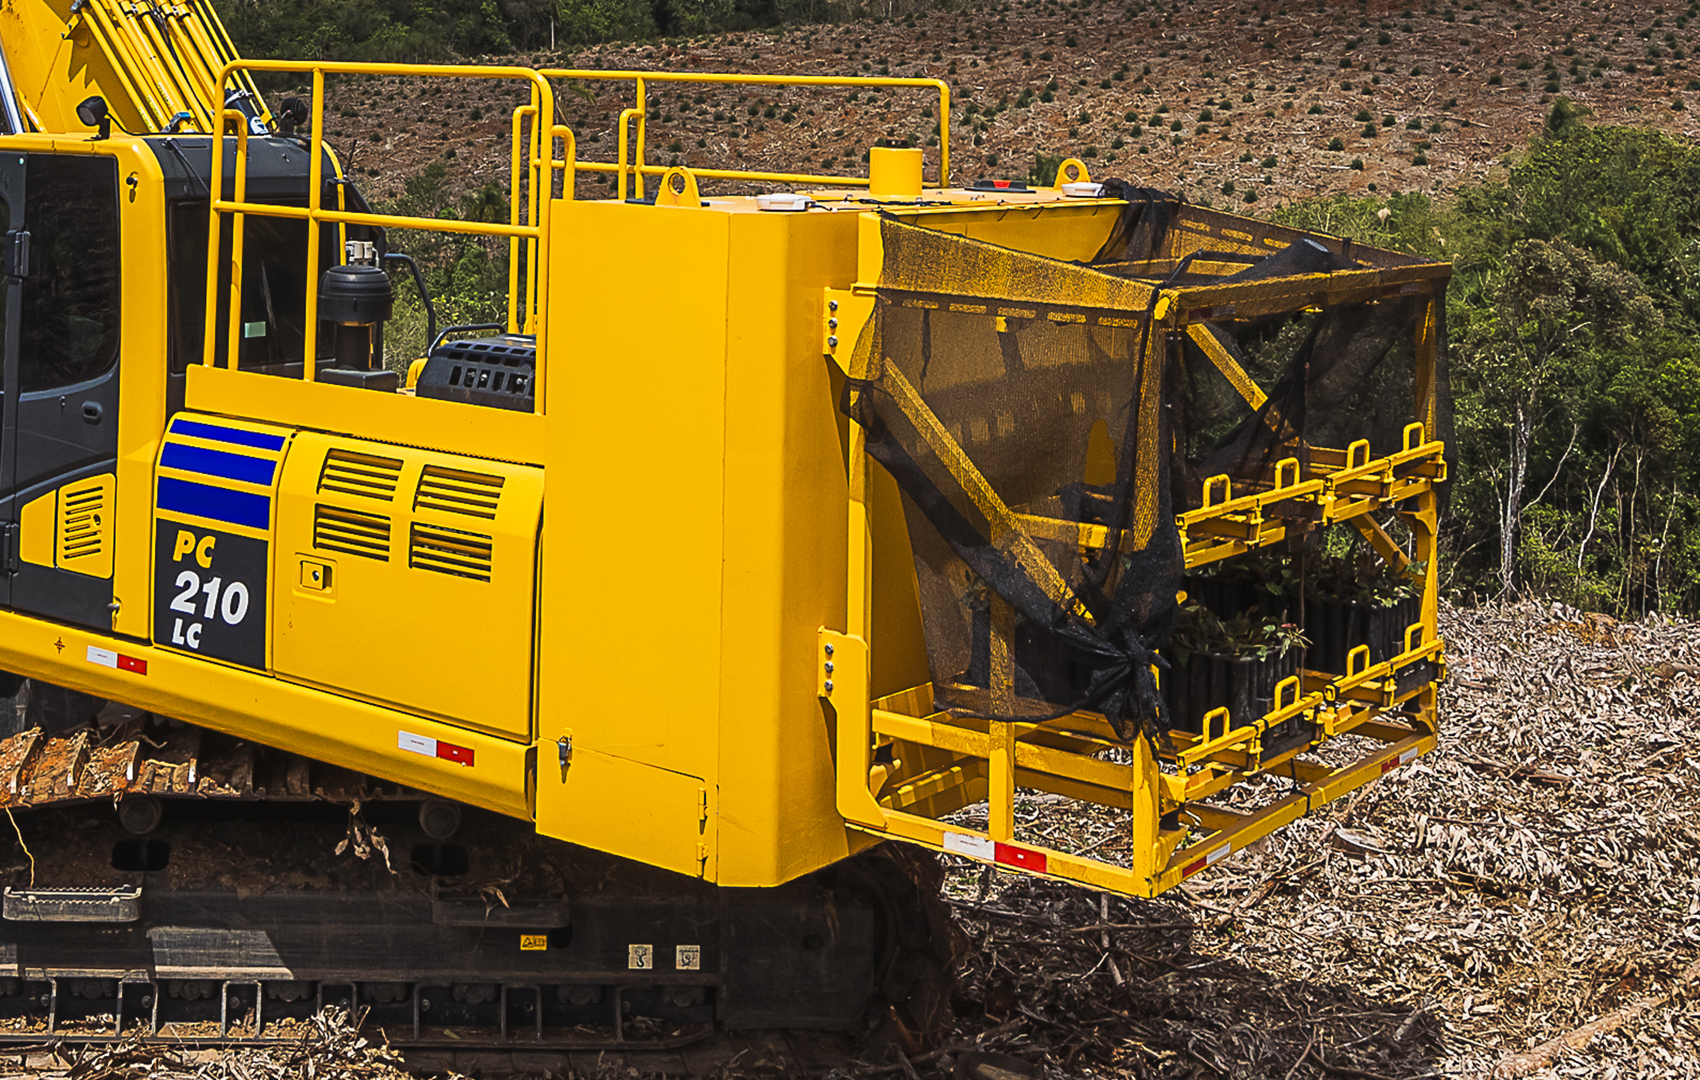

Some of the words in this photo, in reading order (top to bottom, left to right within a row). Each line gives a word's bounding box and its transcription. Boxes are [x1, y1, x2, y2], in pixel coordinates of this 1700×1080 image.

[172, 529, 216, 569] PC
[169, 570, 249, 625] 210
[171, 618, 203, 649] LC
